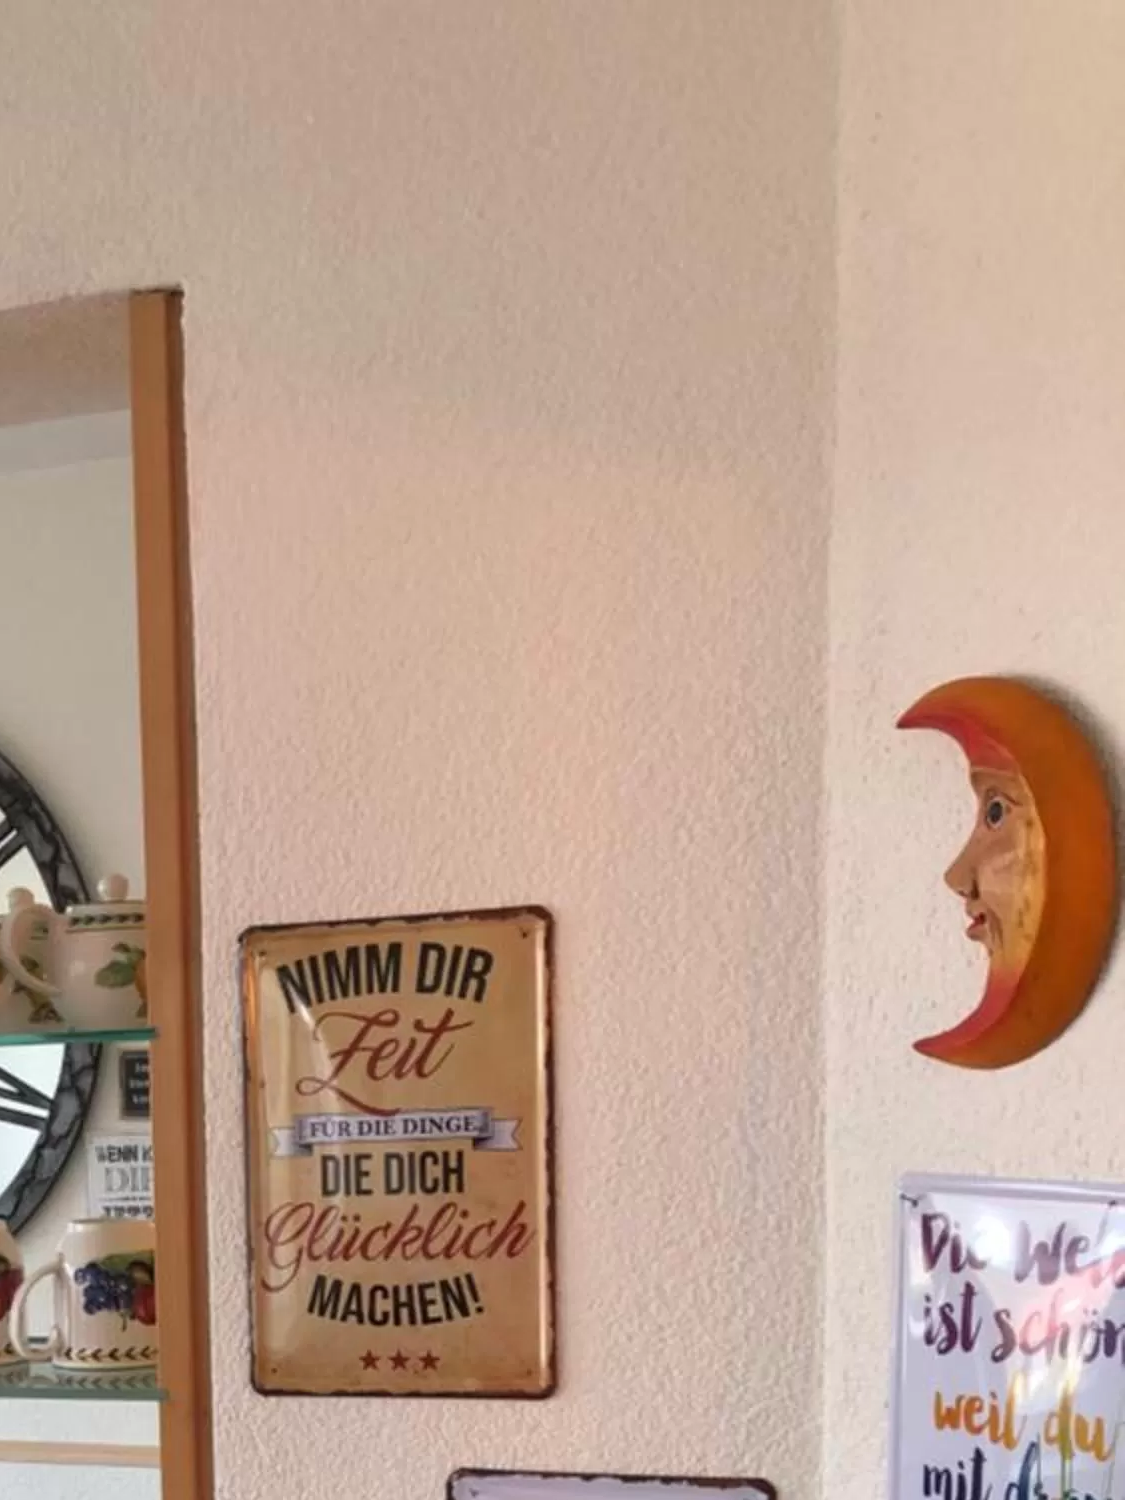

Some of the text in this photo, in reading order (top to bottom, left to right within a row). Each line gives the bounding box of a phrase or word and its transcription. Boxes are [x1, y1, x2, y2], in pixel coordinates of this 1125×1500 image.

[277, 942, 494, 1014] NIMM DIR
[295, 1007, 473, 1117] Zeit
[309, 1117, 352, 1138] FÜR
[357, 1118, 397, 1137] DIE
[321, 1150, 465, 1197] DIE DICH
[261, 1199, 537, 1293] Glücklich
[307, 1272, 485, 1328] MACHEN!
[923, 1280, 983, 1357] ist
[933, 1370, 1114, 1462] weil du
